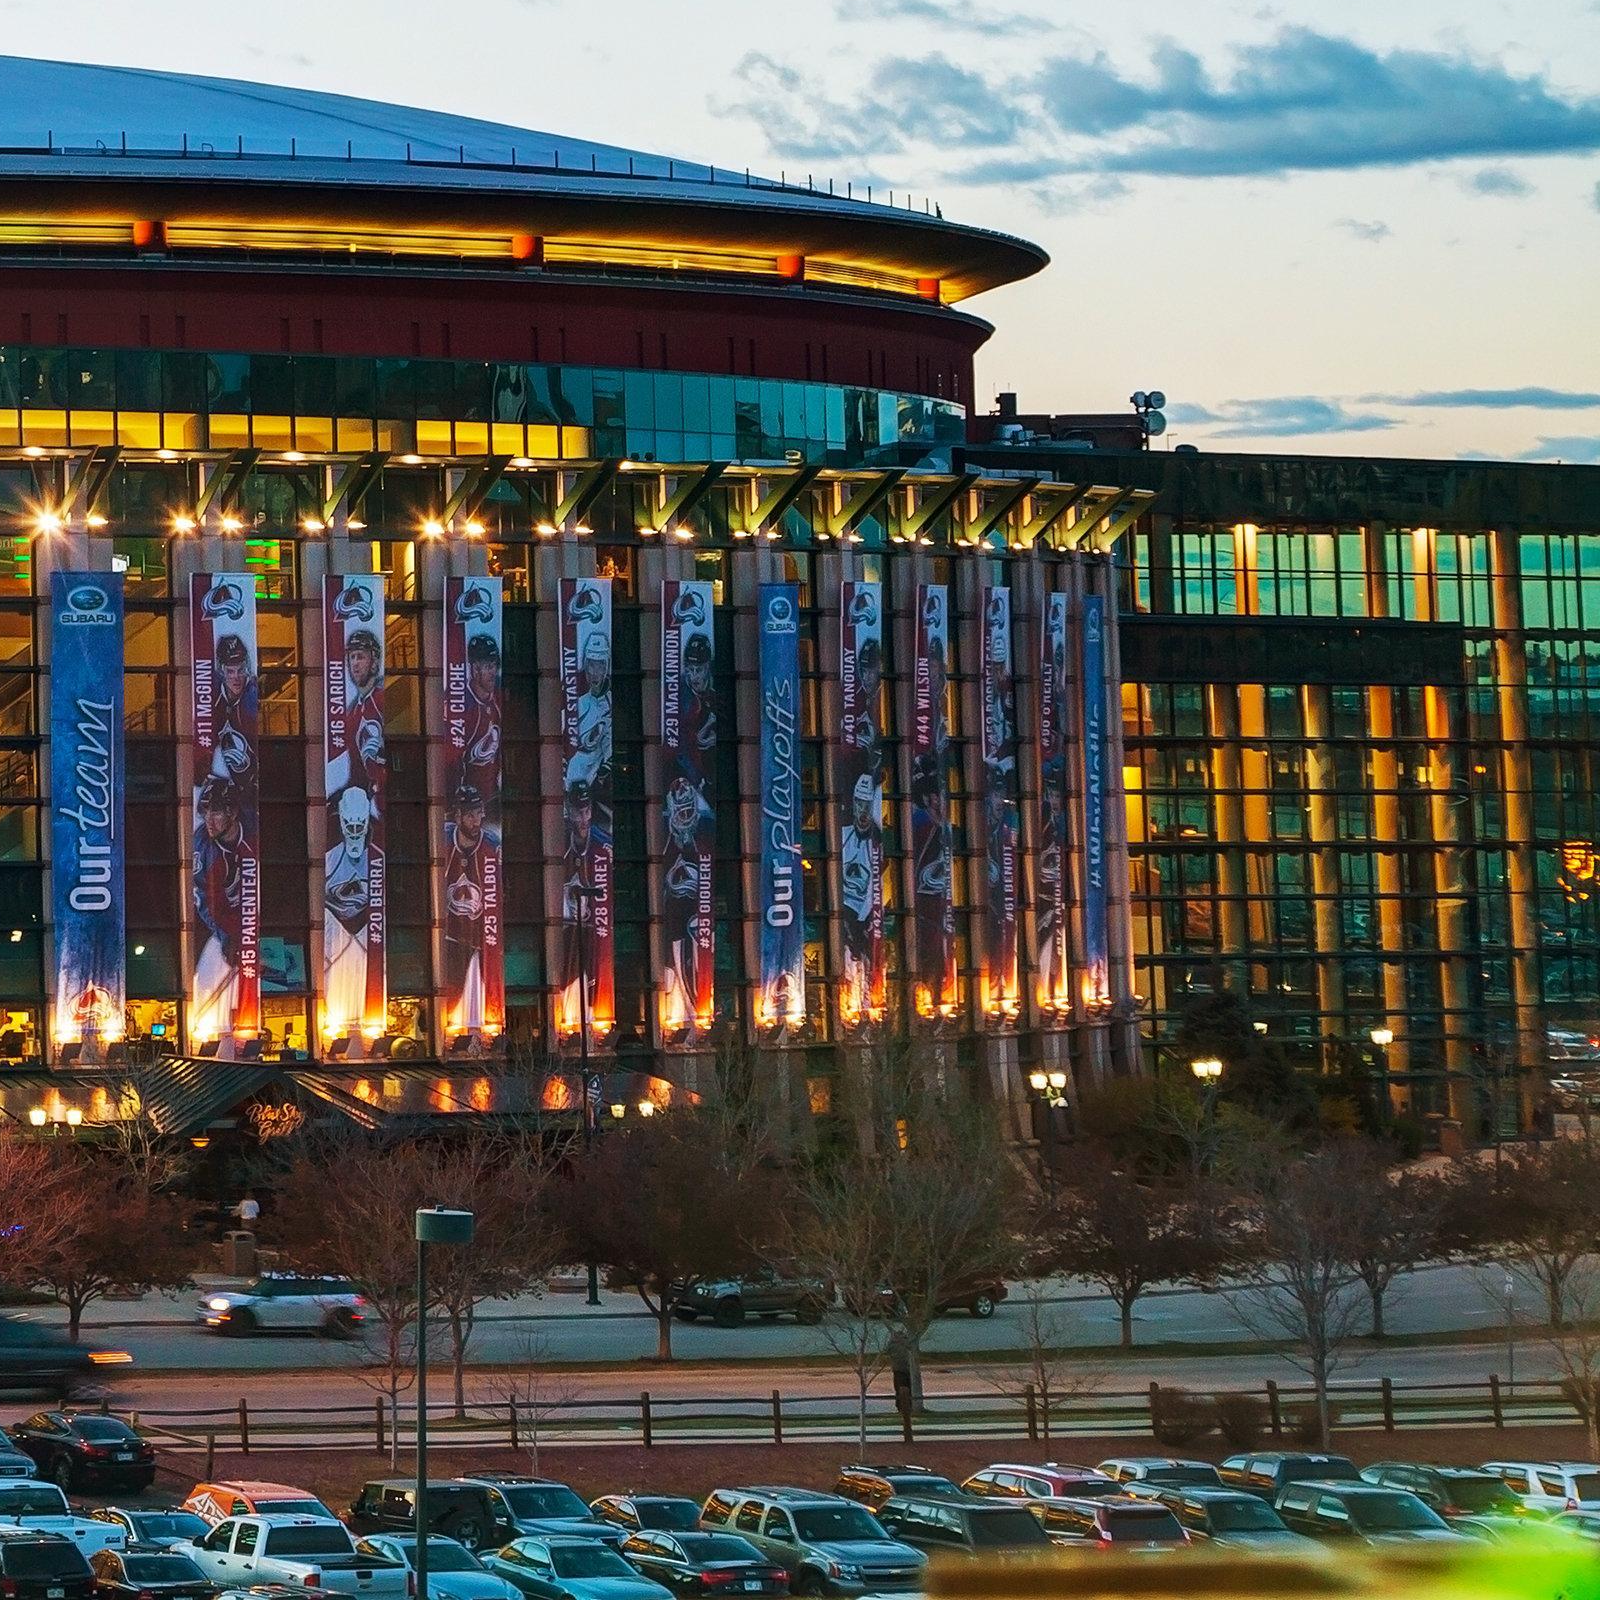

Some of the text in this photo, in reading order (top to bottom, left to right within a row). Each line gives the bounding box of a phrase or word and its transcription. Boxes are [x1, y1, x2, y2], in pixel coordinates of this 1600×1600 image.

[61, 614, 113, 623] SUBARU
[195, 659, 212, 748] #11 McGINN
[329, 660, 345, 748] #16 SARICH
[449, 662, 466, 748] #24 CLICHE
[563, 646, 578, 747] #26 STASTNY
[666, 719, 679, 748] #29
[844, 714, 855, 744] #40
[916, 657, 930, 746] #44 WILSON
[58, 697, 112, 911] Our team
[763, 674, 801, 927] Our playoffs
[369, 857, 383, 944] #20 BERRA
[483, 856, 498, 947] #25 TALBOT
[593, 854, 609, 938] #28 CAREY
[699, 853, 712, 949] #35 GIGUERE
[1003, 844, 1014, 893] BENOIT
[241, 857, 257, 979] #15 PARENTEAU
[245, 1103, 280, 1123] Blue
